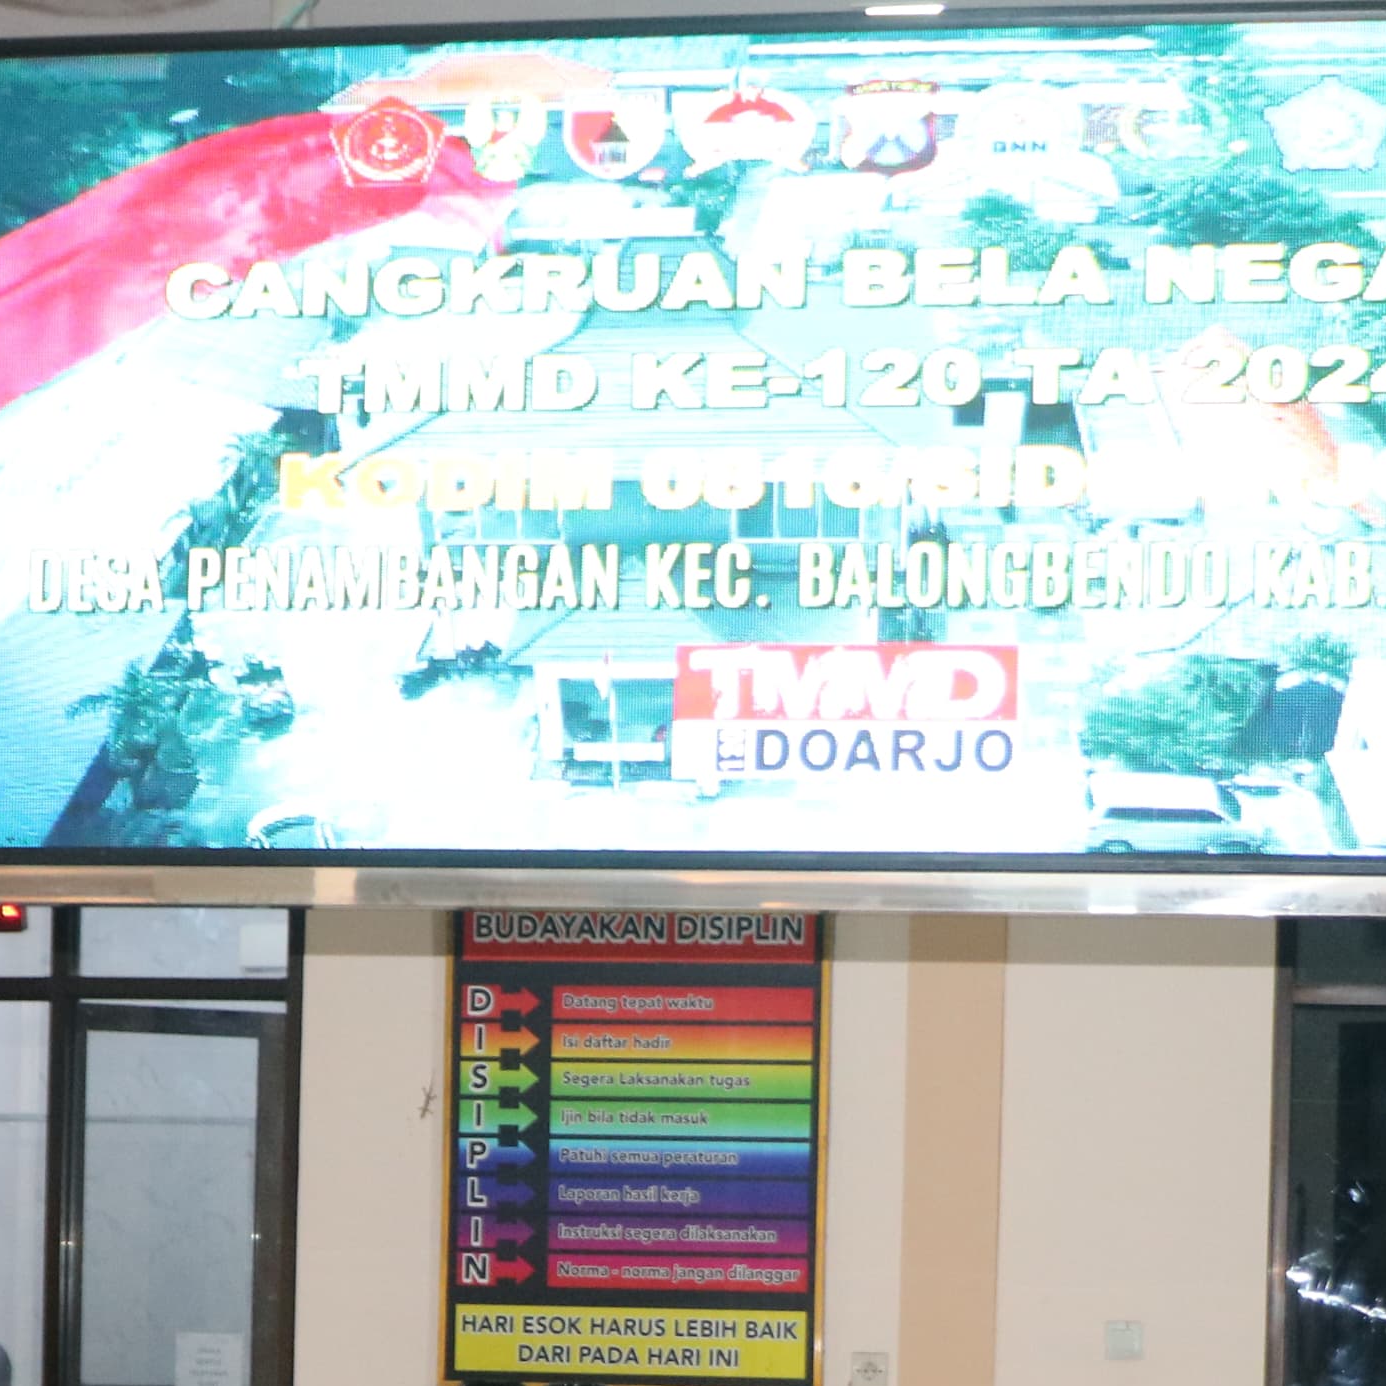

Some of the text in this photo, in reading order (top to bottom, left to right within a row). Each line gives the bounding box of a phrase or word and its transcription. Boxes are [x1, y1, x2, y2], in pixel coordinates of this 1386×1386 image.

[167, 252, 806, 318] CANGKRUAN
[844, 247, 1111, 307] BELA
[301, 352, 598, 414] TMMD
[630, 346, 982, 411] KE-120
[1011, 347, 1156, 405] TA
[279, 452, 614, 511] KODIM
[29, 548, 165, 613] DESA
[188, 544, 618, 612] PENAMBANGAN
[646, 542, 771, 611] KEC.
[798, 542, 1229, 610] BALONGBENDO
[689, 648, 1007, 720] TMMD
[474, 912, 806, 944] BUDAYAKAN DISIPLIN
[562, 994, 715, 1012] Datang tepat waktu
[561, 1034, 671, 1050] Isi daftar hadir
[562, 1072, 751, 1088] Segera Laksanakan tugas
[561, 1110, 709, 1126] Ijin bila tidak masuk
[559, 1149, 739, 1167] Patuhi semua peraturan
[558, 1186, 699, 1206] Laporan hasil kerja
[557, 1225, 777, 1244] Instruksi segera dilaksanakan
[556, 1263, 609, 1278] Norma
[622, 1265, 670, 1280] norma
[672, 1266, 724, 1283] jangan
[727, 1266, 800, 1283] dilanggar
[461, 1315, 798, 1340] HARI ESOK HARUS LEBIH BAIK
[517, 1344, 739, 1368] DARI PADA HARI INI
